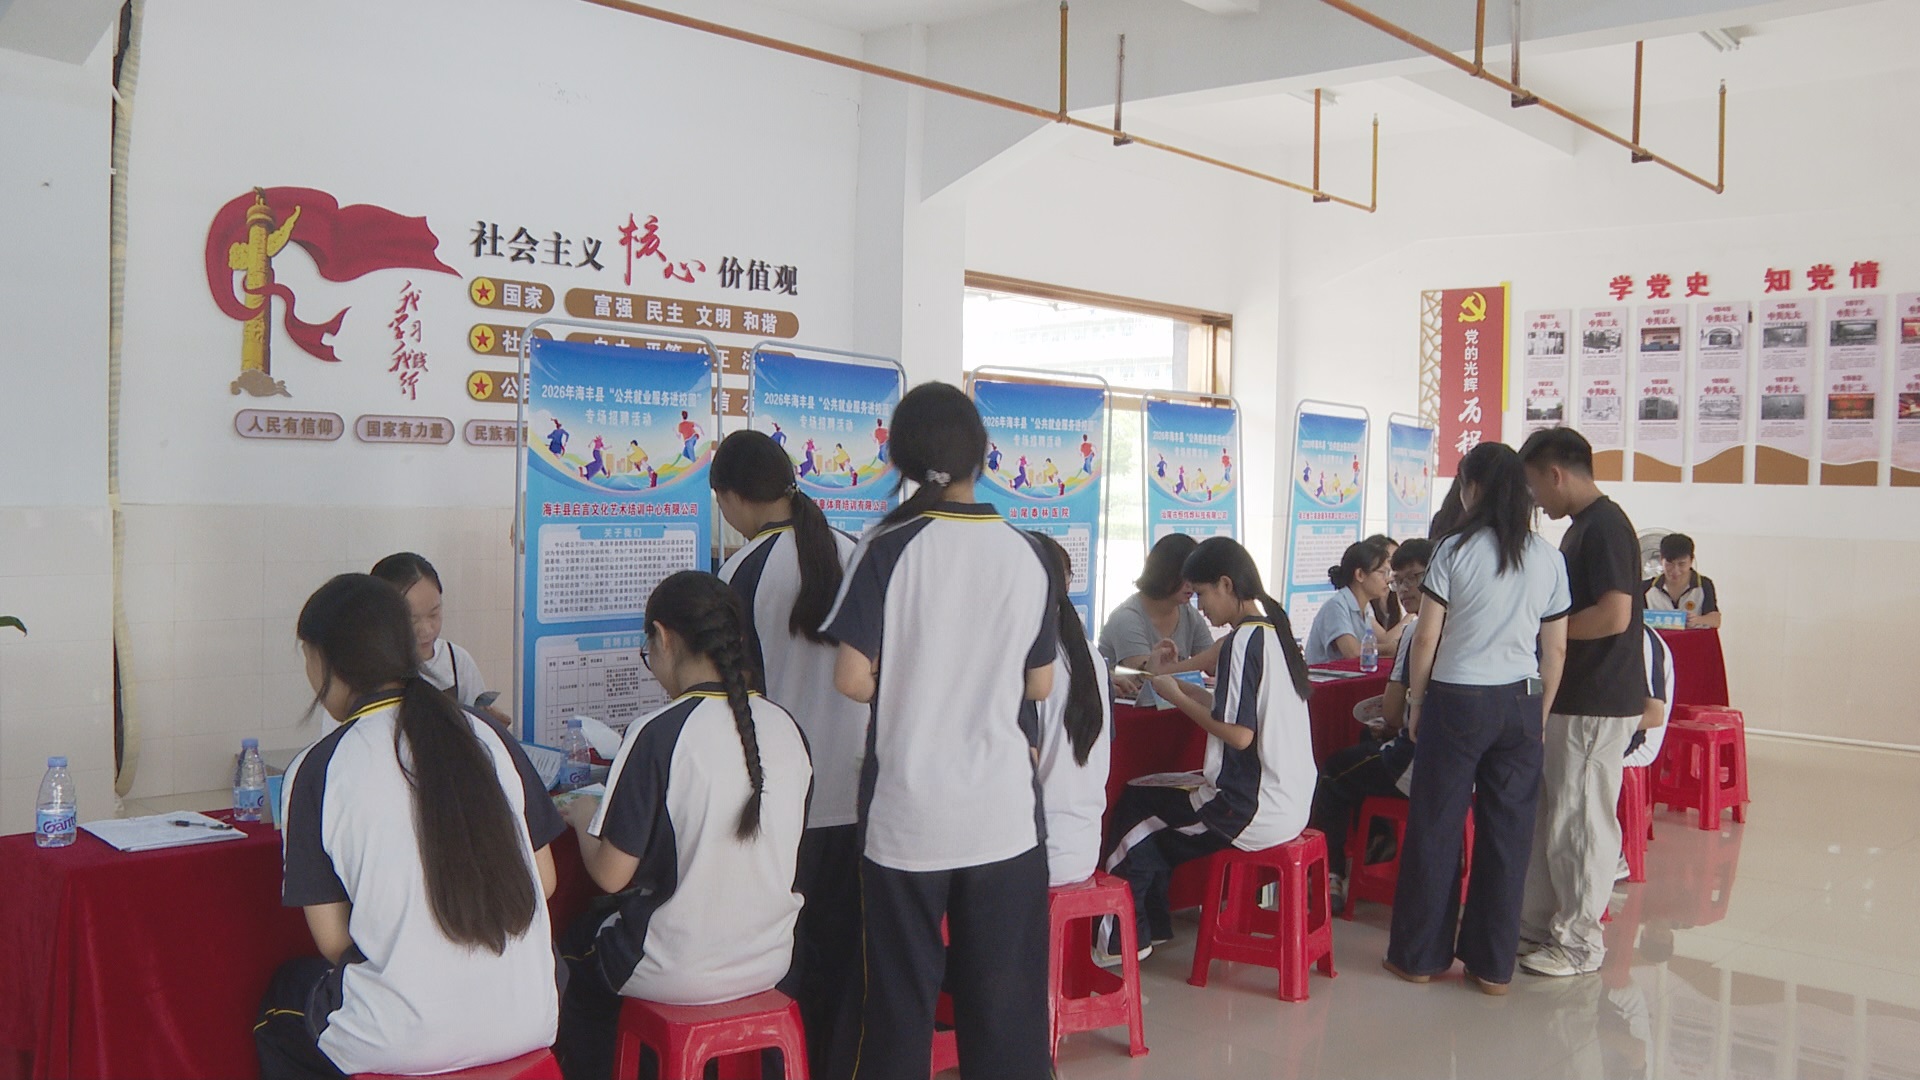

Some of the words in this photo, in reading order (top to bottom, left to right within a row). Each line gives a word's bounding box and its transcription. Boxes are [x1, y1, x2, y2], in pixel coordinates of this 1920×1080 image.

[469, 220, 605, 272] 社会主义
[618, 212, 706, 286] 核心
[717, 256, 799, 296] 价值观
[1609, 272, 1711, 300] 学党史
[1764, 261, 1880, 293] 知党情
[503, 283, 543, 309] 国家
[594, 294, 633, 319] 富强
[646, 300, 684, 324] 民主
[696, 305, 731, 329] 文明
[743, 311, 778, 334] 和谐
[248, 416, 333, 435] 人民有信仰
[585, 408, 653, 426] 专场招聘活动
[366, 420, 445, 440] 国家有力量
[542, 503, 698, 517] 海丰县启言文化艺术培训中心有限公司
[603, 528, 642, 538] 关于我们
